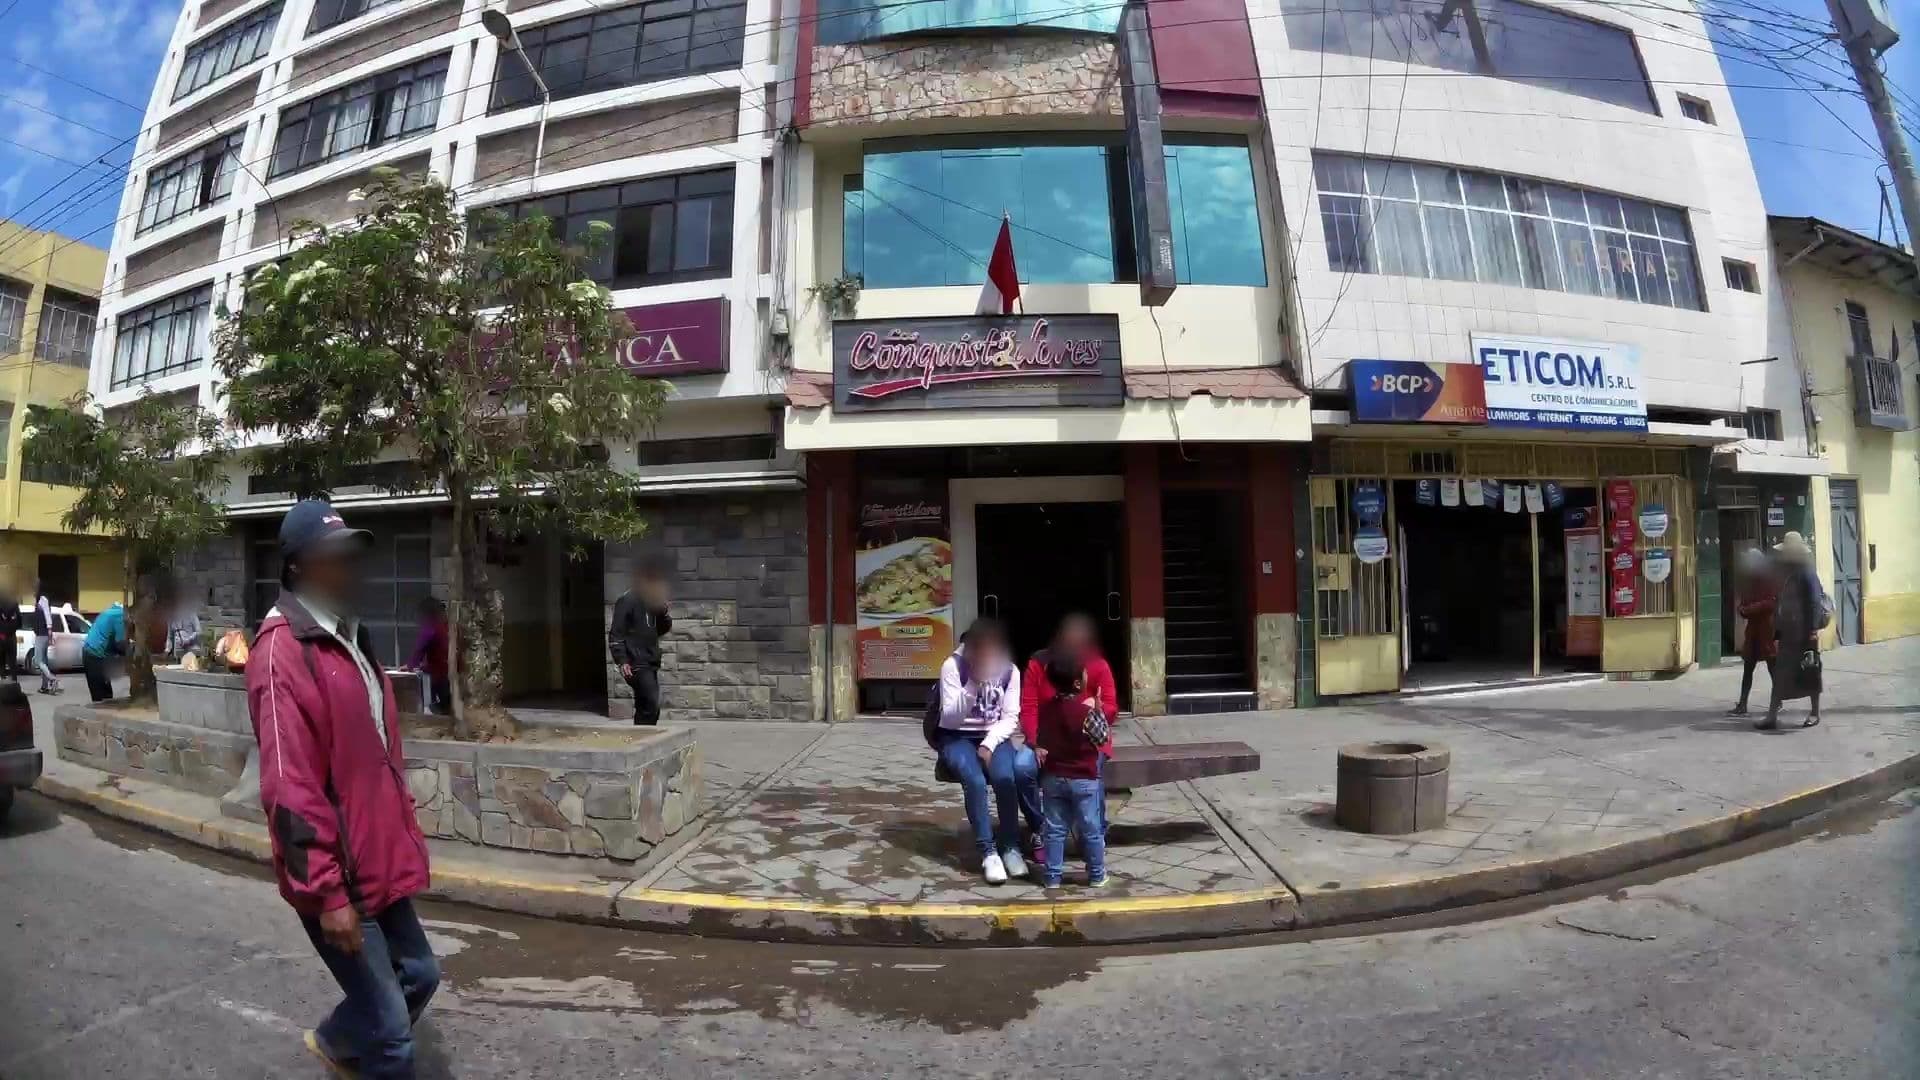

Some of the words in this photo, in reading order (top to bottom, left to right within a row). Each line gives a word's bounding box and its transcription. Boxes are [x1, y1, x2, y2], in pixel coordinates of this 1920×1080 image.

[1479, 347, 1605, 389] ETICOM
[1382, 374, 1423, 393] BCP
[1531, 393, 1562, 404] CENTRO
[1564, 395, 1574, 405] DE
[1575, 396, 1638, 408] COMUNICACIONES
[1486, 410, 1531, 421] LLAMADAS
[1538, 412, 1573, 423] INTERNET
[1580, 415, 1617, 426] RECARGAS
